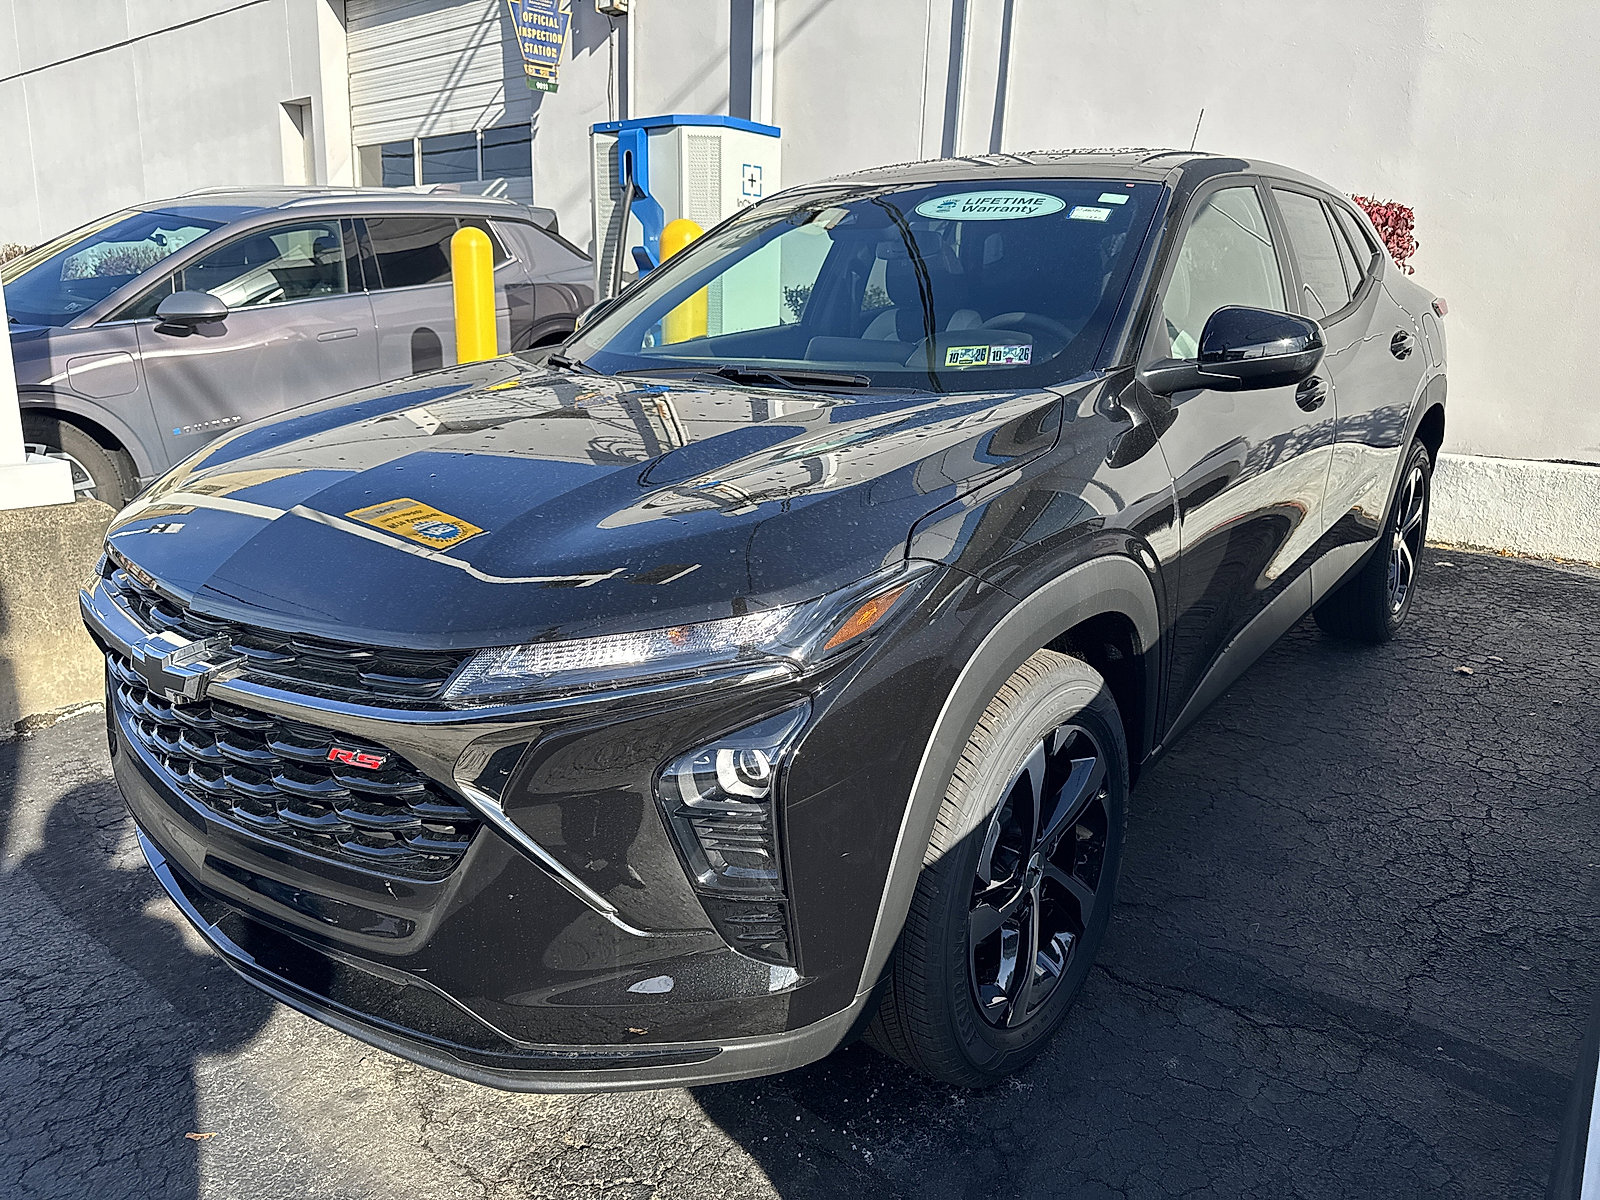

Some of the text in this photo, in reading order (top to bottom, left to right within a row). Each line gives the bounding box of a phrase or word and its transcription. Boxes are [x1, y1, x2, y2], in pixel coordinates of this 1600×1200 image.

[522, 11, 559, 29] OFFICIAL
[519, 26, 563, 44] INSPECTION
[523, 42, 557, 58] STATION
[965, 197, 1047, 205] LIFETIME
[961, 204, 1039, 215] Warranty
[949, 348, 987, 364] 10 26
[992, 347, 1030, 362] 10 26
[327, 747, 387, 770] RS
